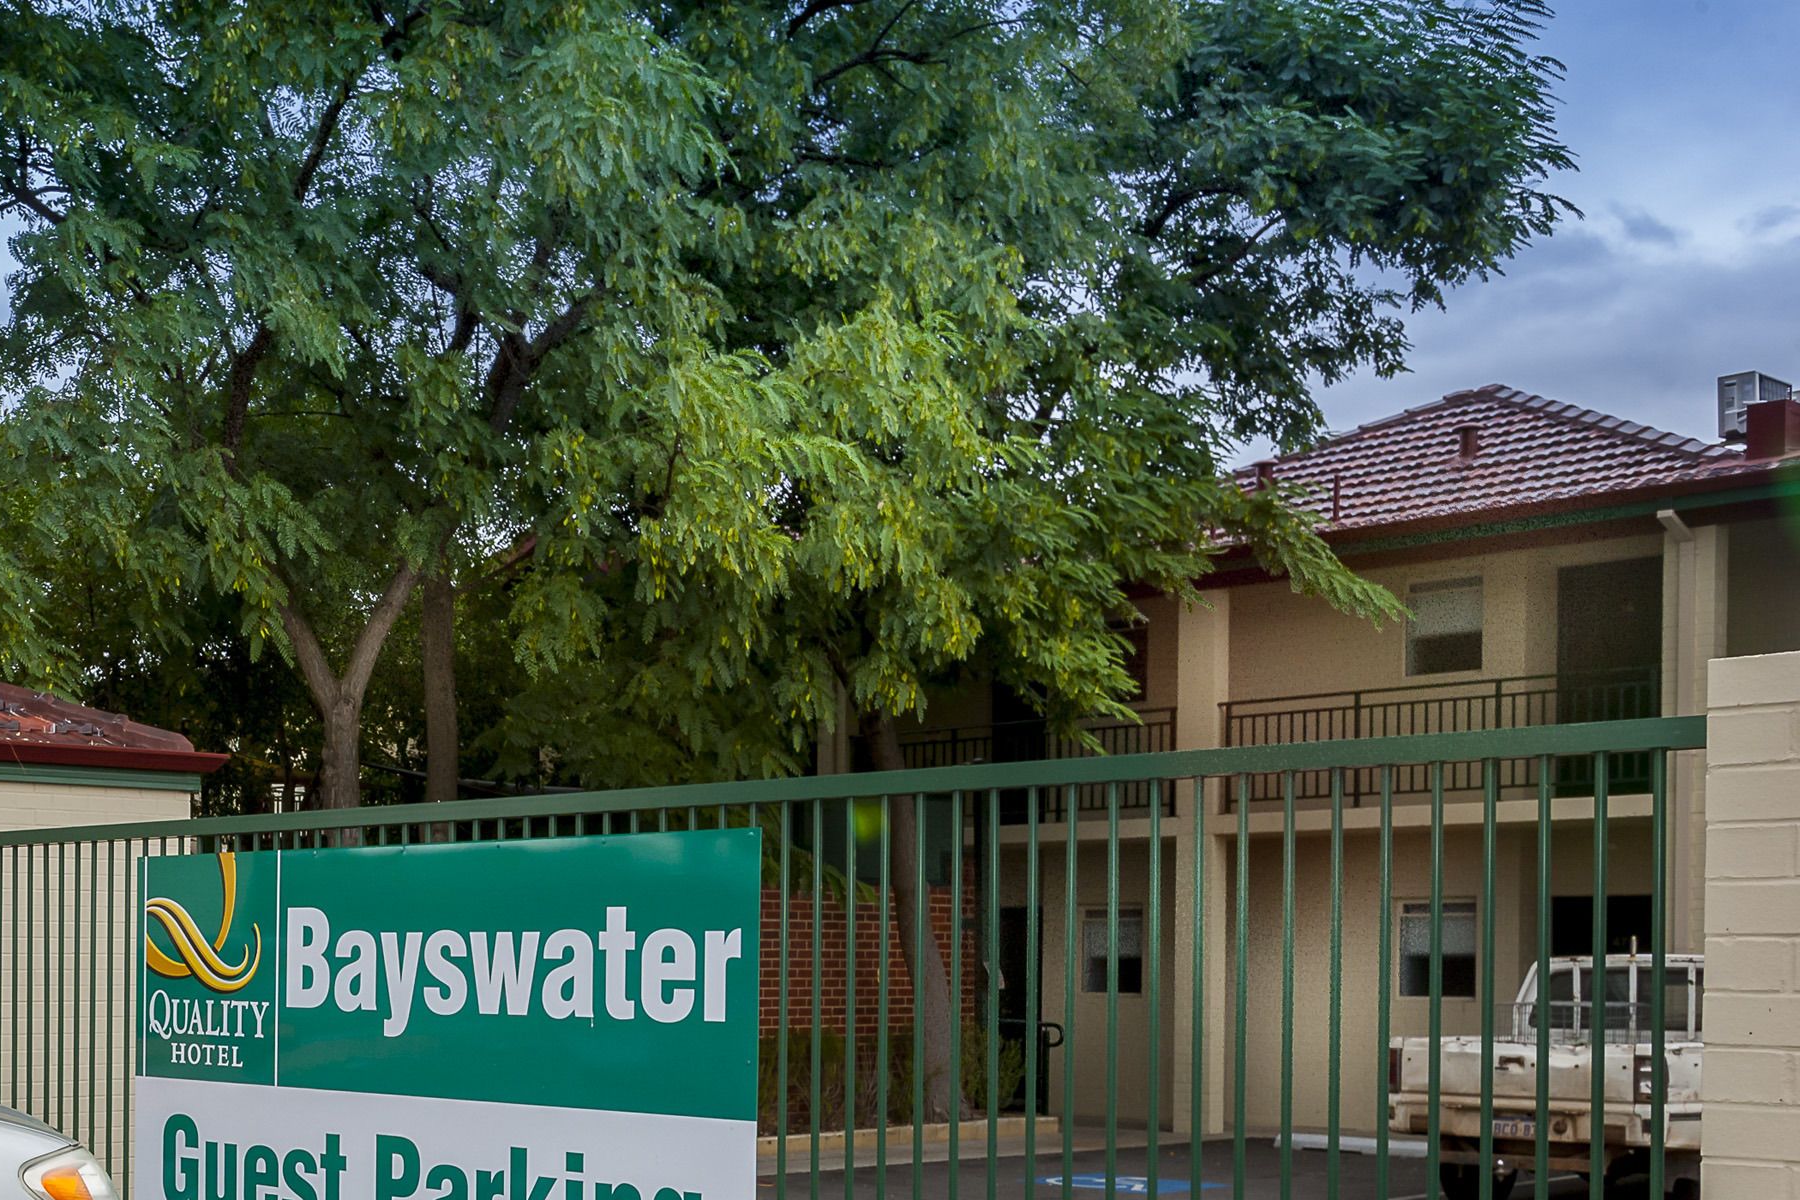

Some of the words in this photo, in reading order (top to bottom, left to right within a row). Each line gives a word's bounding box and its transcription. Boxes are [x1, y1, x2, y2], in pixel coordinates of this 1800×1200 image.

[285, 905, 741, 1038] Bayswater
[149, 989, 270, 1040] QUALITY
[170, 1042, 244, 1067] HOTEL
